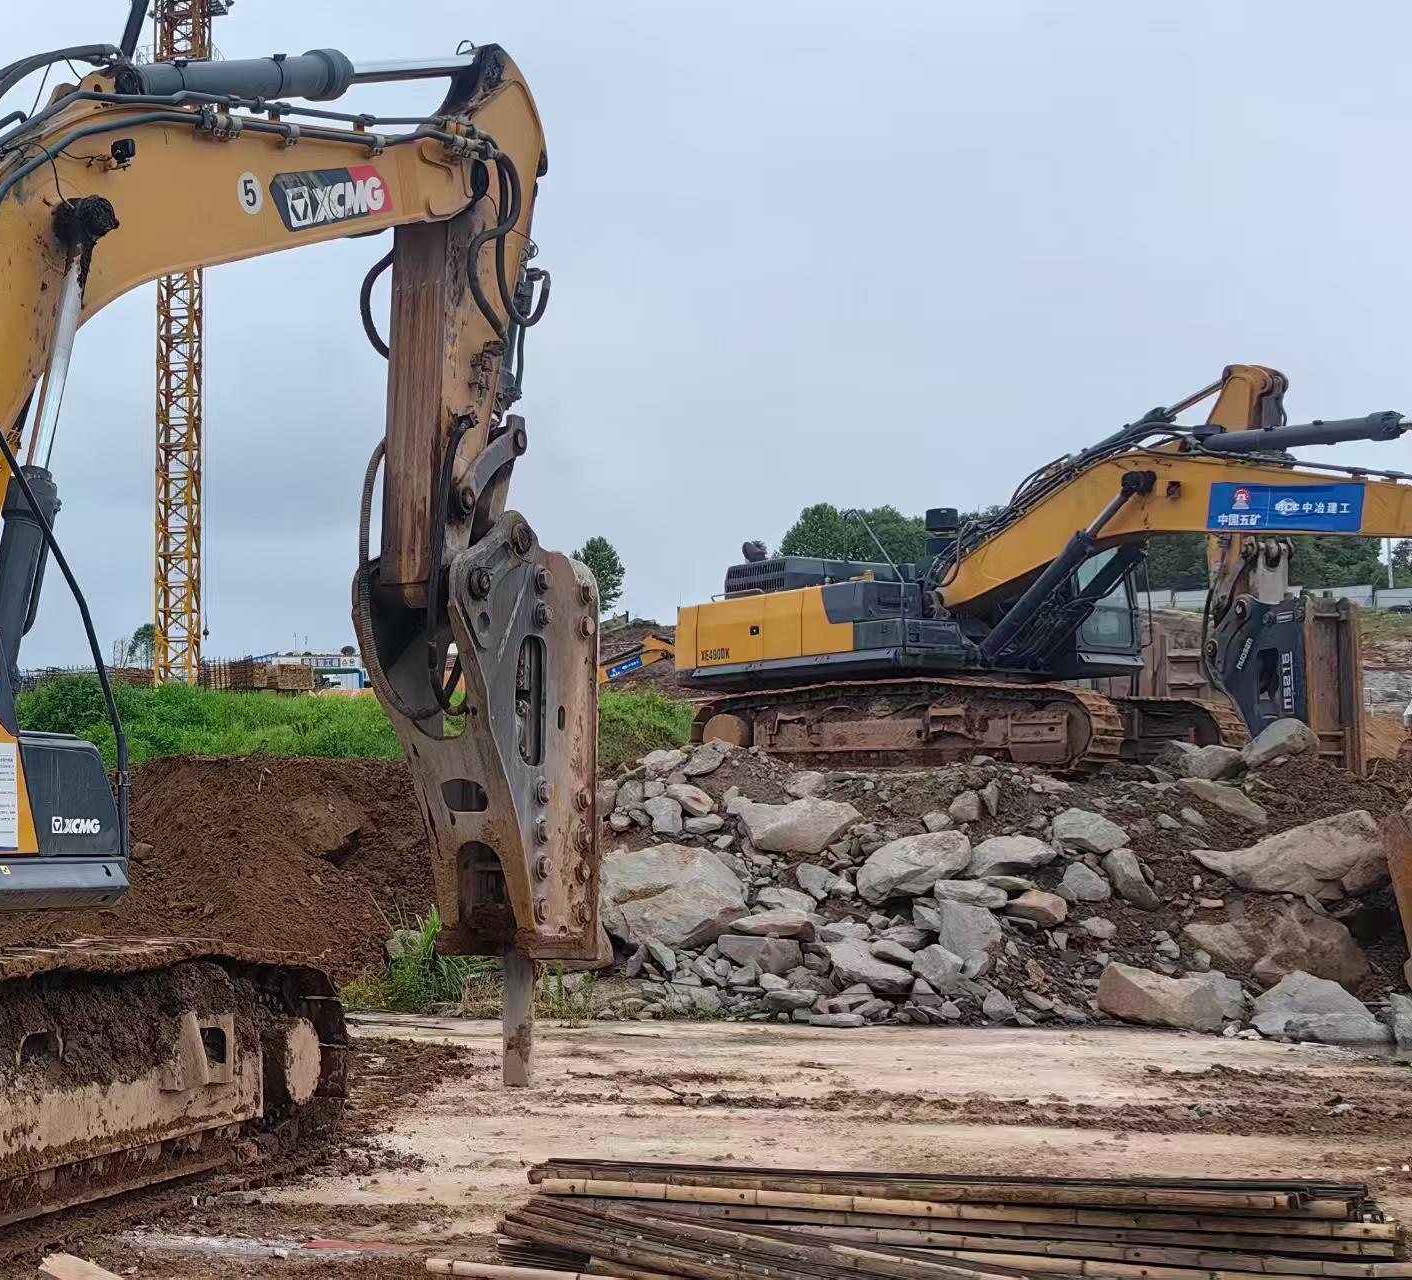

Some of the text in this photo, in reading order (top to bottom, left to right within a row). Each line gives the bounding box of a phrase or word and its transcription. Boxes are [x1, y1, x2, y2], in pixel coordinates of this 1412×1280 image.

[242, 179, 257, 207] 5
[312, 177, 385, 223] XCMG
[1302, 501, 1350, 514] 中冶建工
[1217, 513, 1261, 526] 中国五矿
[62, 818, 101, 834] XCMG
